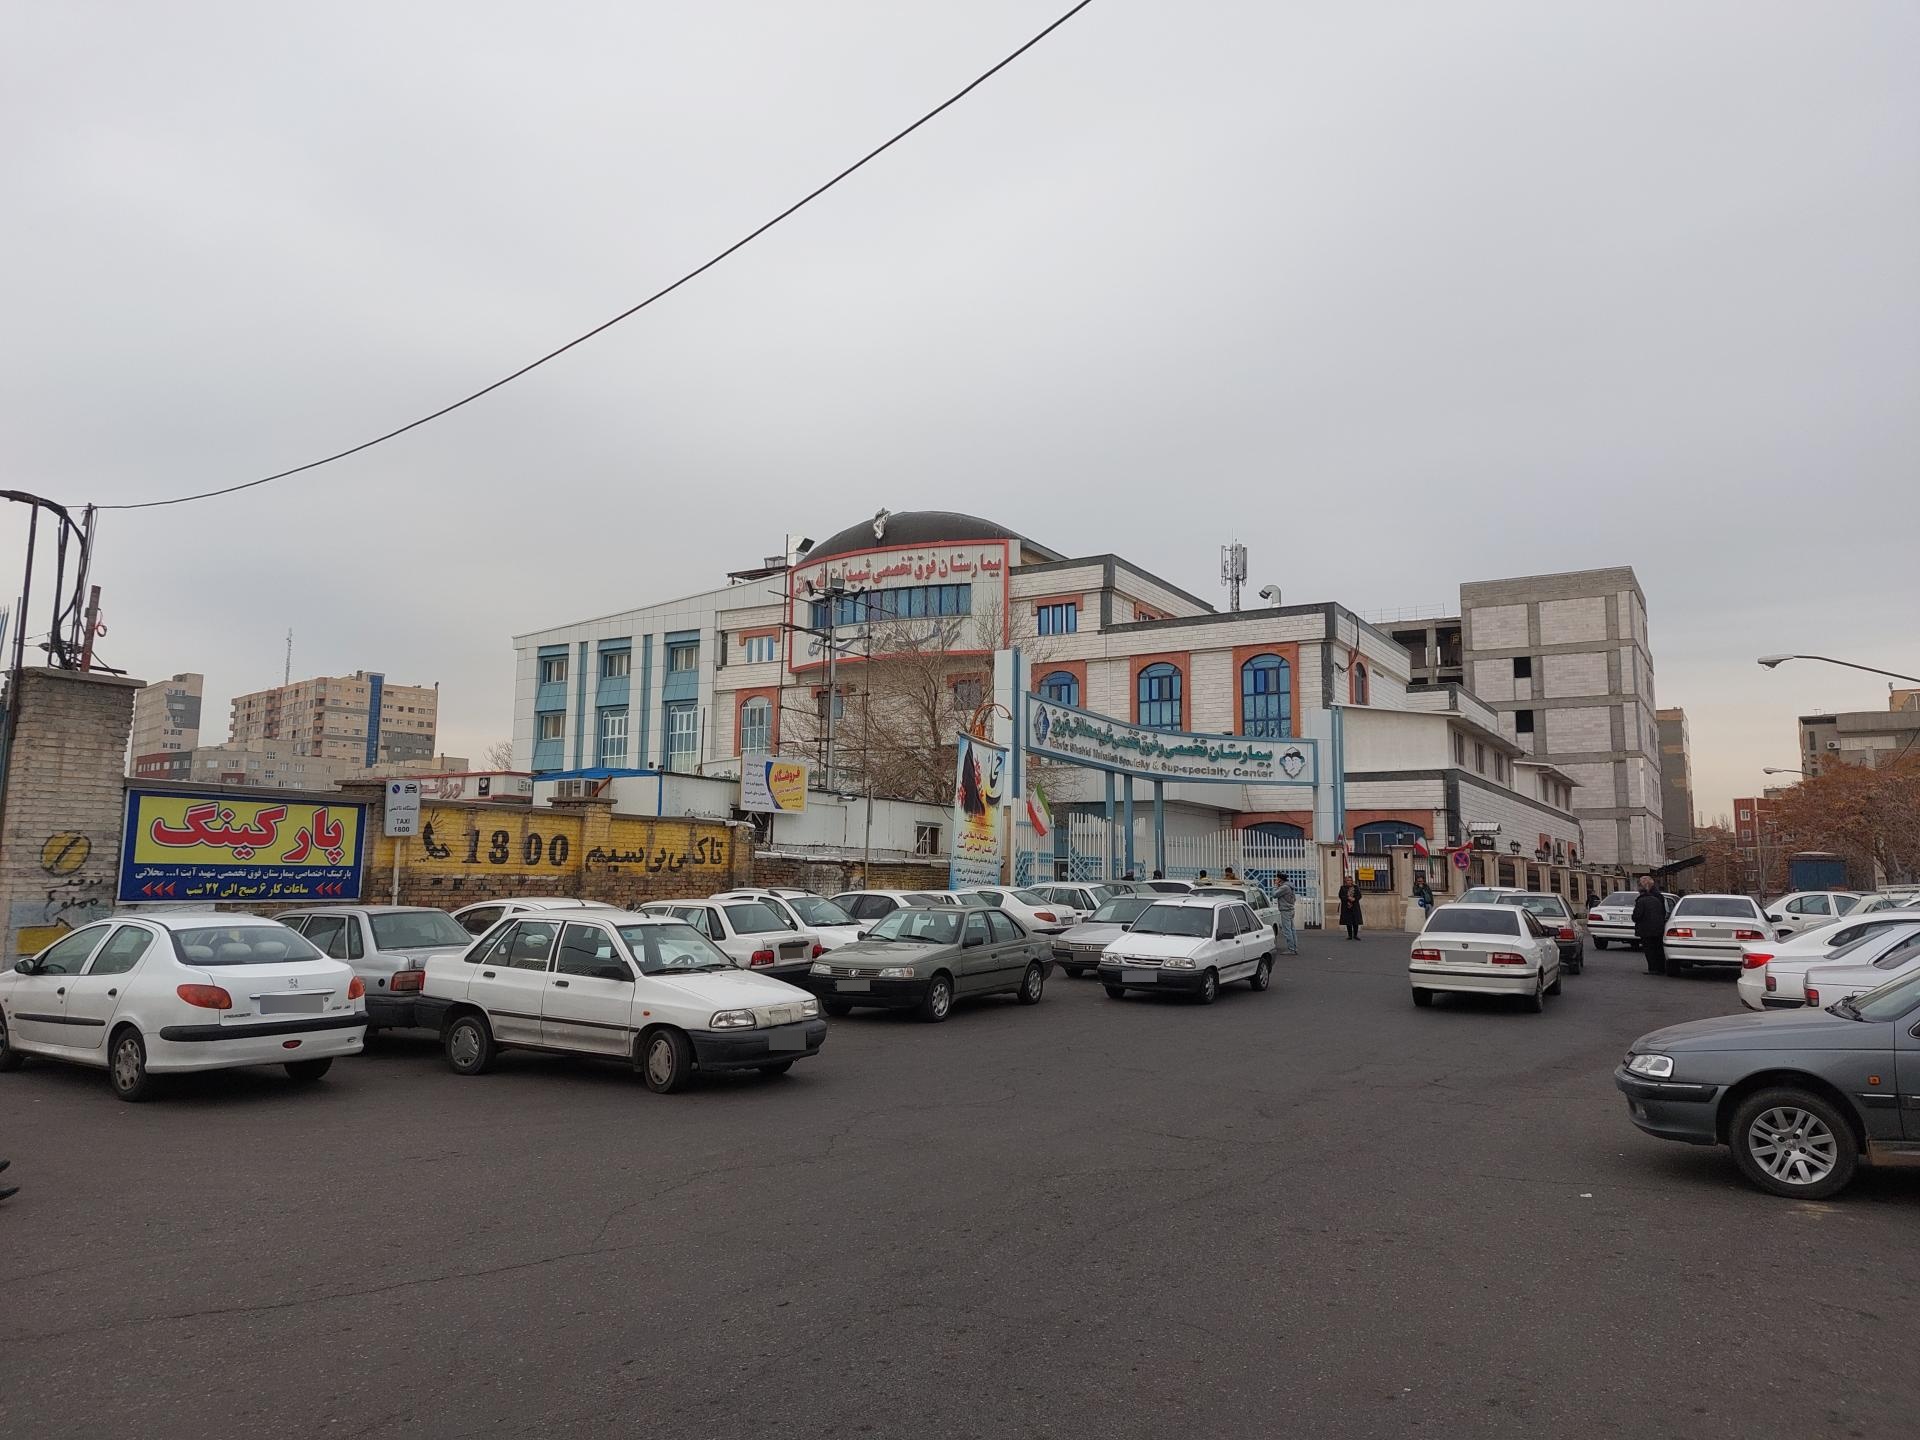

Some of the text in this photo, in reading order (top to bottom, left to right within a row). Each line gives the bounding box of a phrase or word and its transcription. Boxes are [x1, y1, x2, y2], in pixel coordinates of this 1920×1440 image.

[846, 559, 871, 589] شهید
[873, 555, 912, 583] تخصصی
[914, 552, 937, 580] فوق
[938, 552, 1002, 578] بیمارستان
[1112, 729, 1140, 750] تخصصی
[1139, 733, 1159, 756] فوق
[1164, 738, 1208, 759] تخصصی
[1207, 743, 1274, 768] بیمارستان
[773, 766, 801, 784] فروشگاه
[1161, 761, 1231, 778] Sup-specialty
[1233, 767, 1274, 779] Center
[151, 802, 345, 865] پارکینگ
[462, 828, 570, 866] 1800
[668, 836, 724, 872] تاکسی
[135, 867, 165, 879] محلاتی
[181, 866, 197, 878] آیت
[198, 868, 216, 877] شهید
[217, 868, 247, 879] تخصصی
[247, 868, 262, 880] فوق
[262, 869, 294, 880] بیمارستان
[295, 868, 326, 879] اختصاصی
[326, 869, 352, 880] پارکینگ
[186, 882, 309, 897] ساعات کار ۶ صبح الی ۲۲ شب
